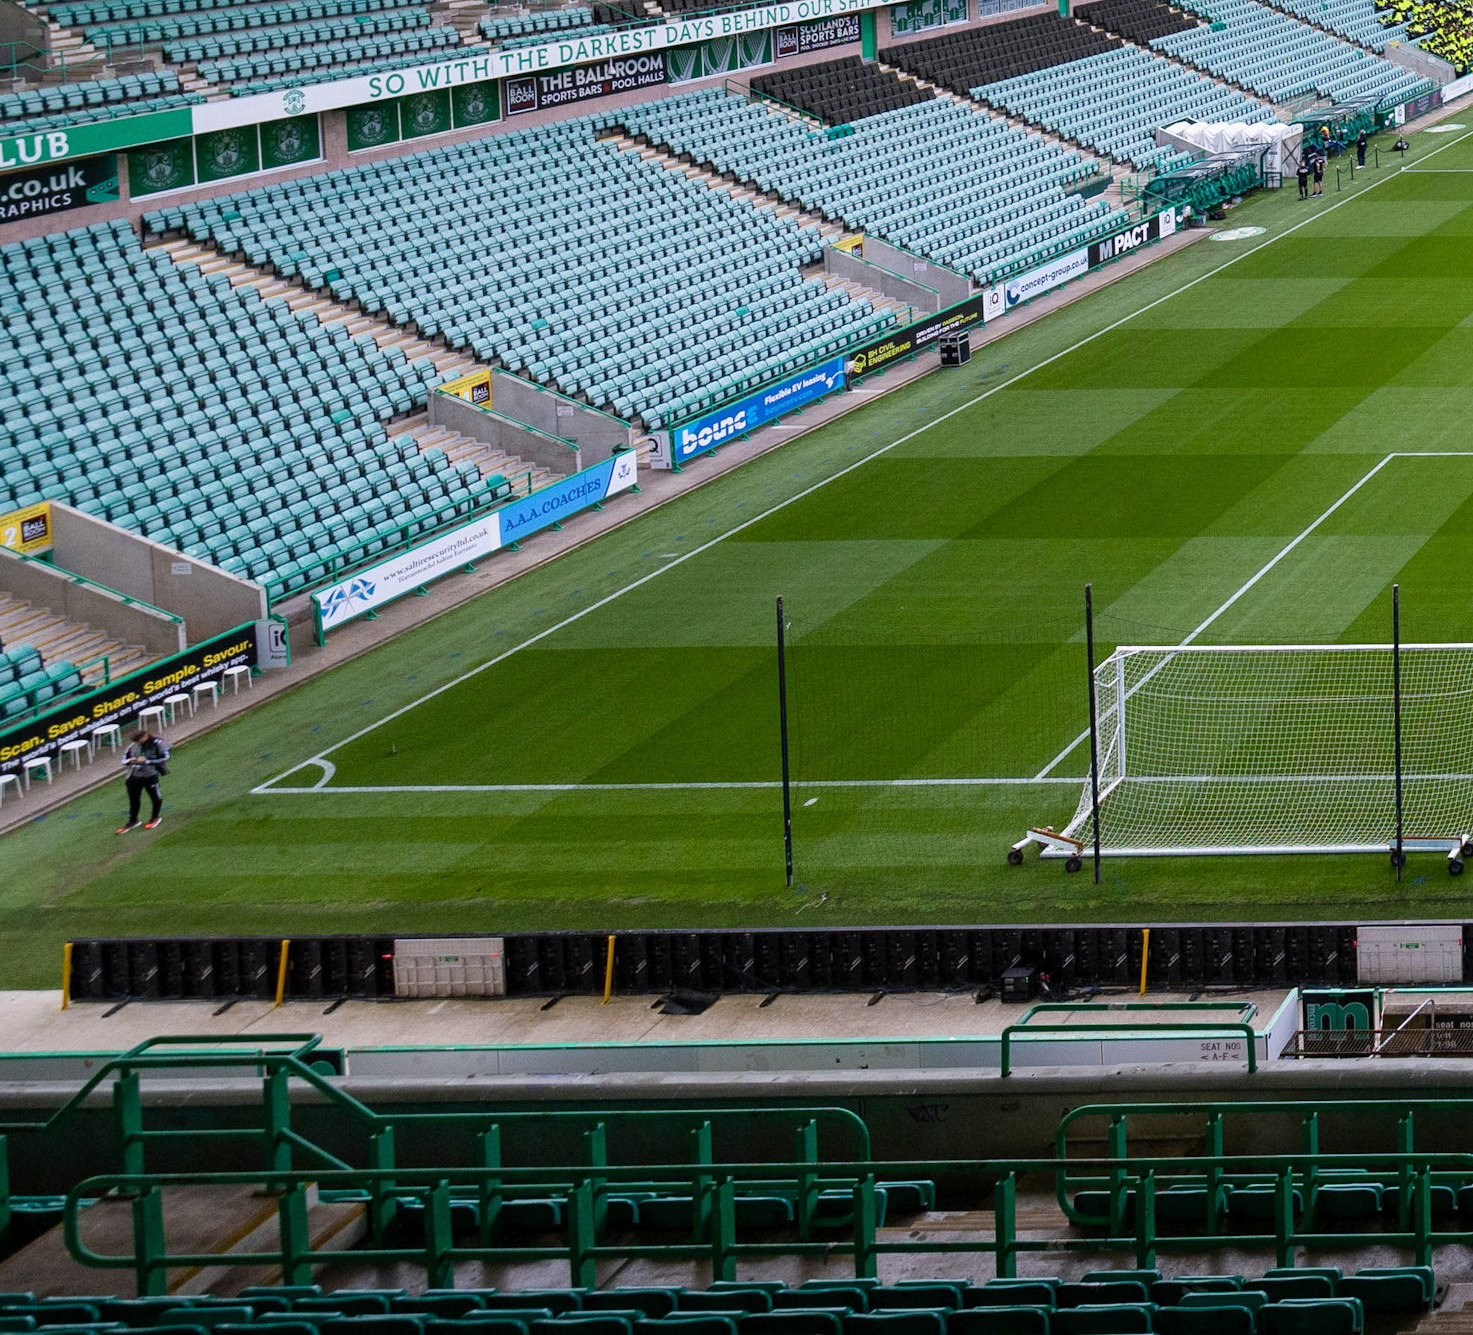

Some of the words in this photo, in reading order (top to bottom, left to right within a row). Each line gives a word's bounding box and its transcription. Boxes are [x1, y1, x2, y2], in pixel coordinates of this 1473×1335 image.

[800, 16, 851, 35] SCOTLAND'S
[800, 30, 834, 45] SPORTS
[836, 24, 859, 37] BARS
[369, 73, 405, 98] SO
[417, 58, 488, 88] WITH
[501, 48, 549, 74] THE
[560, 25, 656, 63] DARKEST
[666, 20, 714, 44] DAYS
[540, 71, 573, 93] THE
[615, 53, 663, 77] ROOM
[510, 84, 534, 97] BALL
[510, 92, 535, 105] ROOM
[541, 89, 577, 105] SPORTS
[579, 83, 602, 98] BARS
[612, 78, 636, 91] POOL
[638, 72, 665, 86] HALLS
[1, 166, 86, 202] .co.uk
[1021, 256, 1087, 292] concept-group.co.uk
[916, 324, 936, 337] DRIVEN
[916, 328, 939, 344] BUILDING
[868, 341, 911, 366] ENGINEERING
[877, 342, 894, 353] CIVIL
[765, 383, 792, 406] Flexible
[802, 372, 826, 389] leasing
[505, 509, 541, 532] A.A.A.
[543, 478, 602, 514] COACHES
[5, 527, 17, 547] 2
[383, 528, 488, 580] www.saltiresecurityltd.co.uk
[0, 735, 44, 760] Scan.
[48, 716, 90, 740] Save.
[93, 692, 140, 720] Share.
[143, 665, 200, 699] Sample.
[202, 640, 253, 669] Savour.
[23, 742, 56, 761] world's
[57, 733, 71, 747] best
[72, 719, 118, 741] whiskies
[131, 700, 146, 713] the
[149, 685, 178, 704] world's
[179, 674, 200, 688] best
[200, 662, 230, 680] whisky
[231, 654, 249, 667] app.
[1436, 1020, 1456, 1029] seat
[1200, 1042, 1222, 1051] SEAT
[1225, 1042, 1241, 1050] NOS
[1212, 1052, 1229, 1060] A-F
